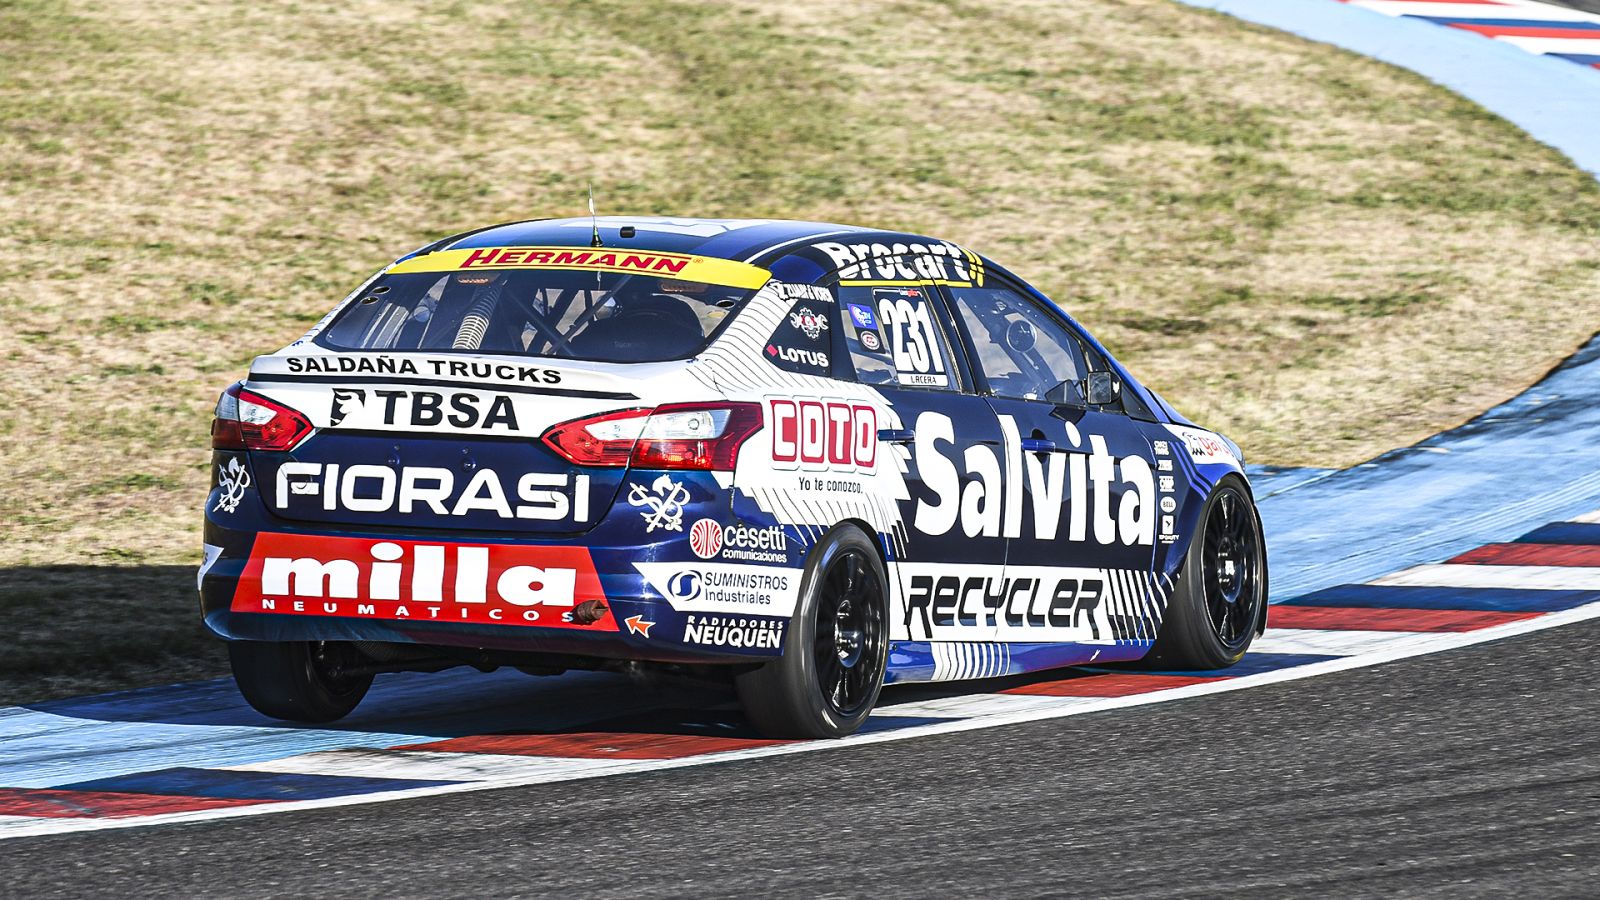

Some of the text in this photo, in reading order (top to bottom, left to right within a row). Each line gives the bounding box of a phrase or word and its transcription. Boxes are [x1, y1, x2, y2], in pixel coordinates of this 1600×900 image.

[459, 249, 691, 273] HERMANN
[811, 241, 970, 281] Brocart
[879, 298, 944, 373] 231
[286, 355, 562, 384] SALDAÑA TRUCKS
[778, 345, 829, 368] LOTUS
[374, 389, 520, 431] TBSA
[772, 401, 876, 464] COTO
[276, 462, 590, 522] FIORASI
[799, 477, 863, 494] Yo te conozco.
[914, 411, 1155, 546] Salvita
[722, 549, 787, 563] comunicaciones
[261, 543, 576, 606] milla
[704, 572, 788, 590] SUMINISTROS
[262, 598, 574, 623] NEUMATICOS
[705, 590, 771, 605] Industriales
[687, 616, 783, 630] RADIADORES
